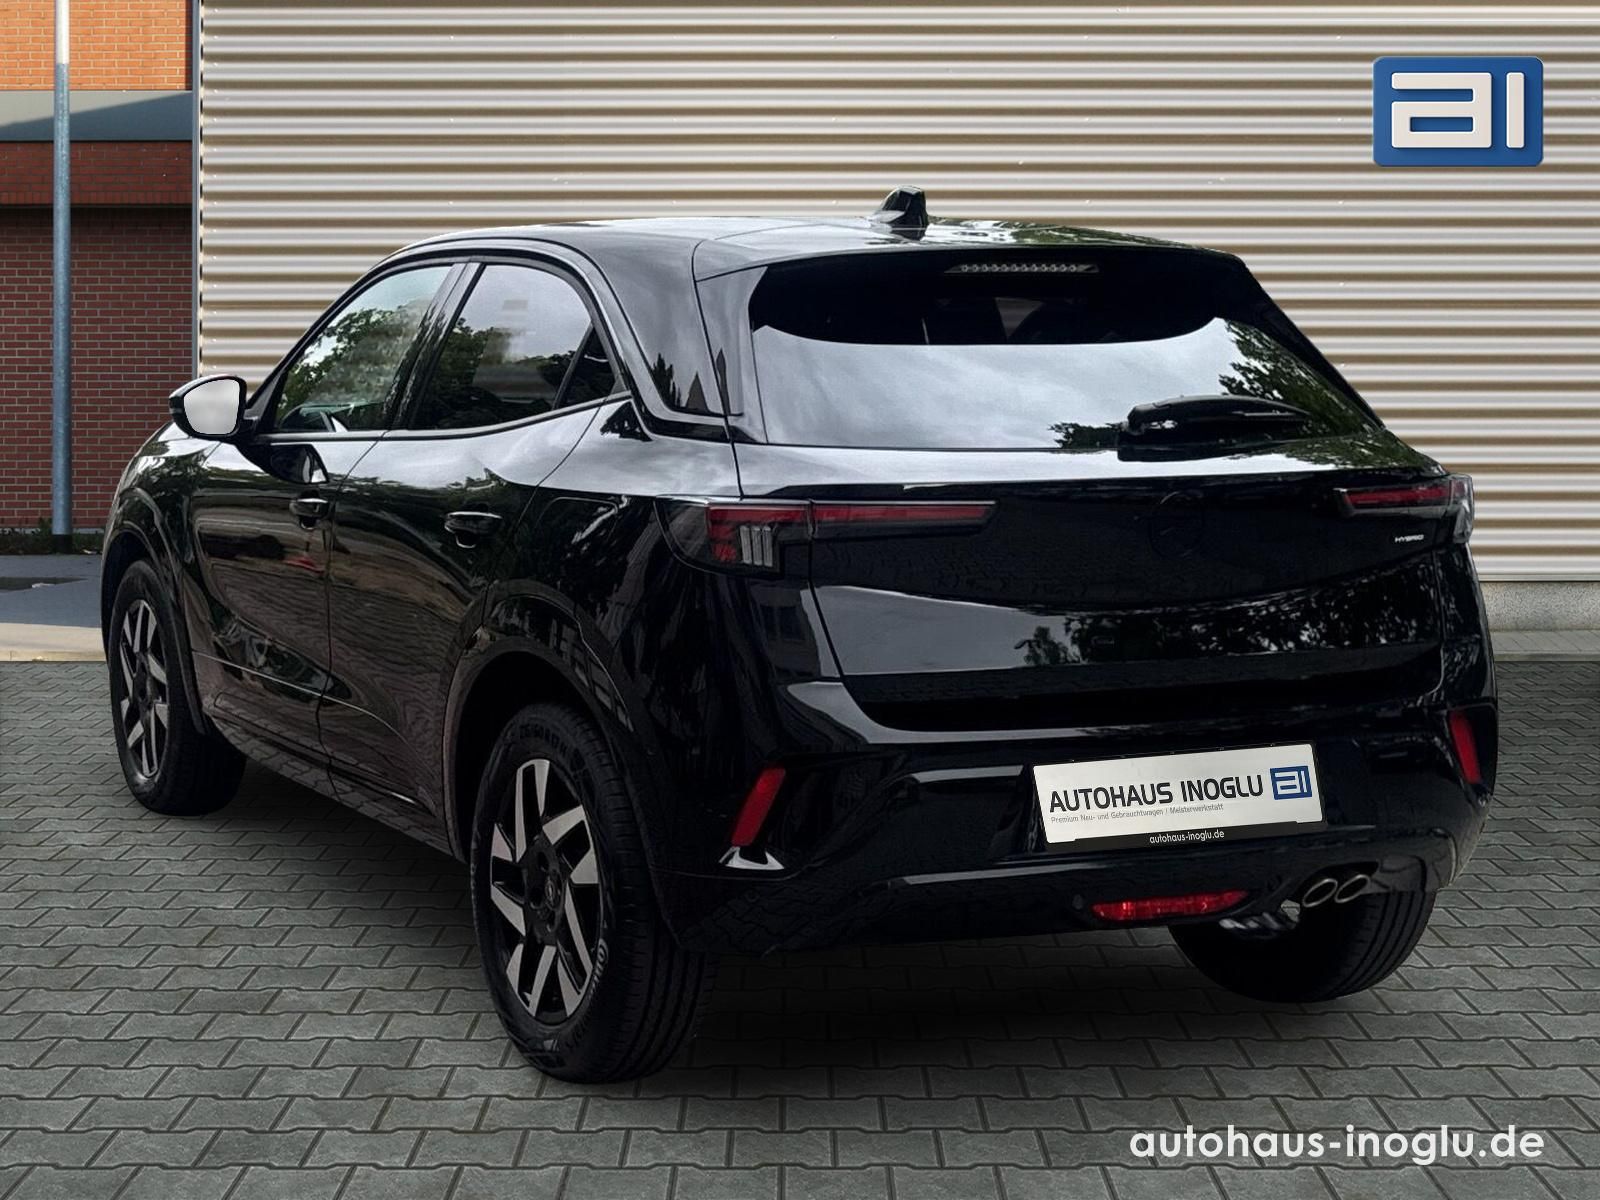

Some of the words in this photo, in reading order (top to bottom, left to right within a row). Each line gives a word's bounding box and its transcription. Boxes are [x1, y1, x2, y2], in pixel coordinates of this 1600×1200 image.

[1394, 534, 1425, 543] HYBRID
[1049, 782, 1173, 813] AUTOHAUS
[1181, 774, 1264, 802] INOGLU
[1110, 808, 1164, 819] Gebrauchtwagen
[1169, 803, 1223, 814] Meisterwerkstatt
[1149, 829, 1225, 844] autohaus-inoglu.de
